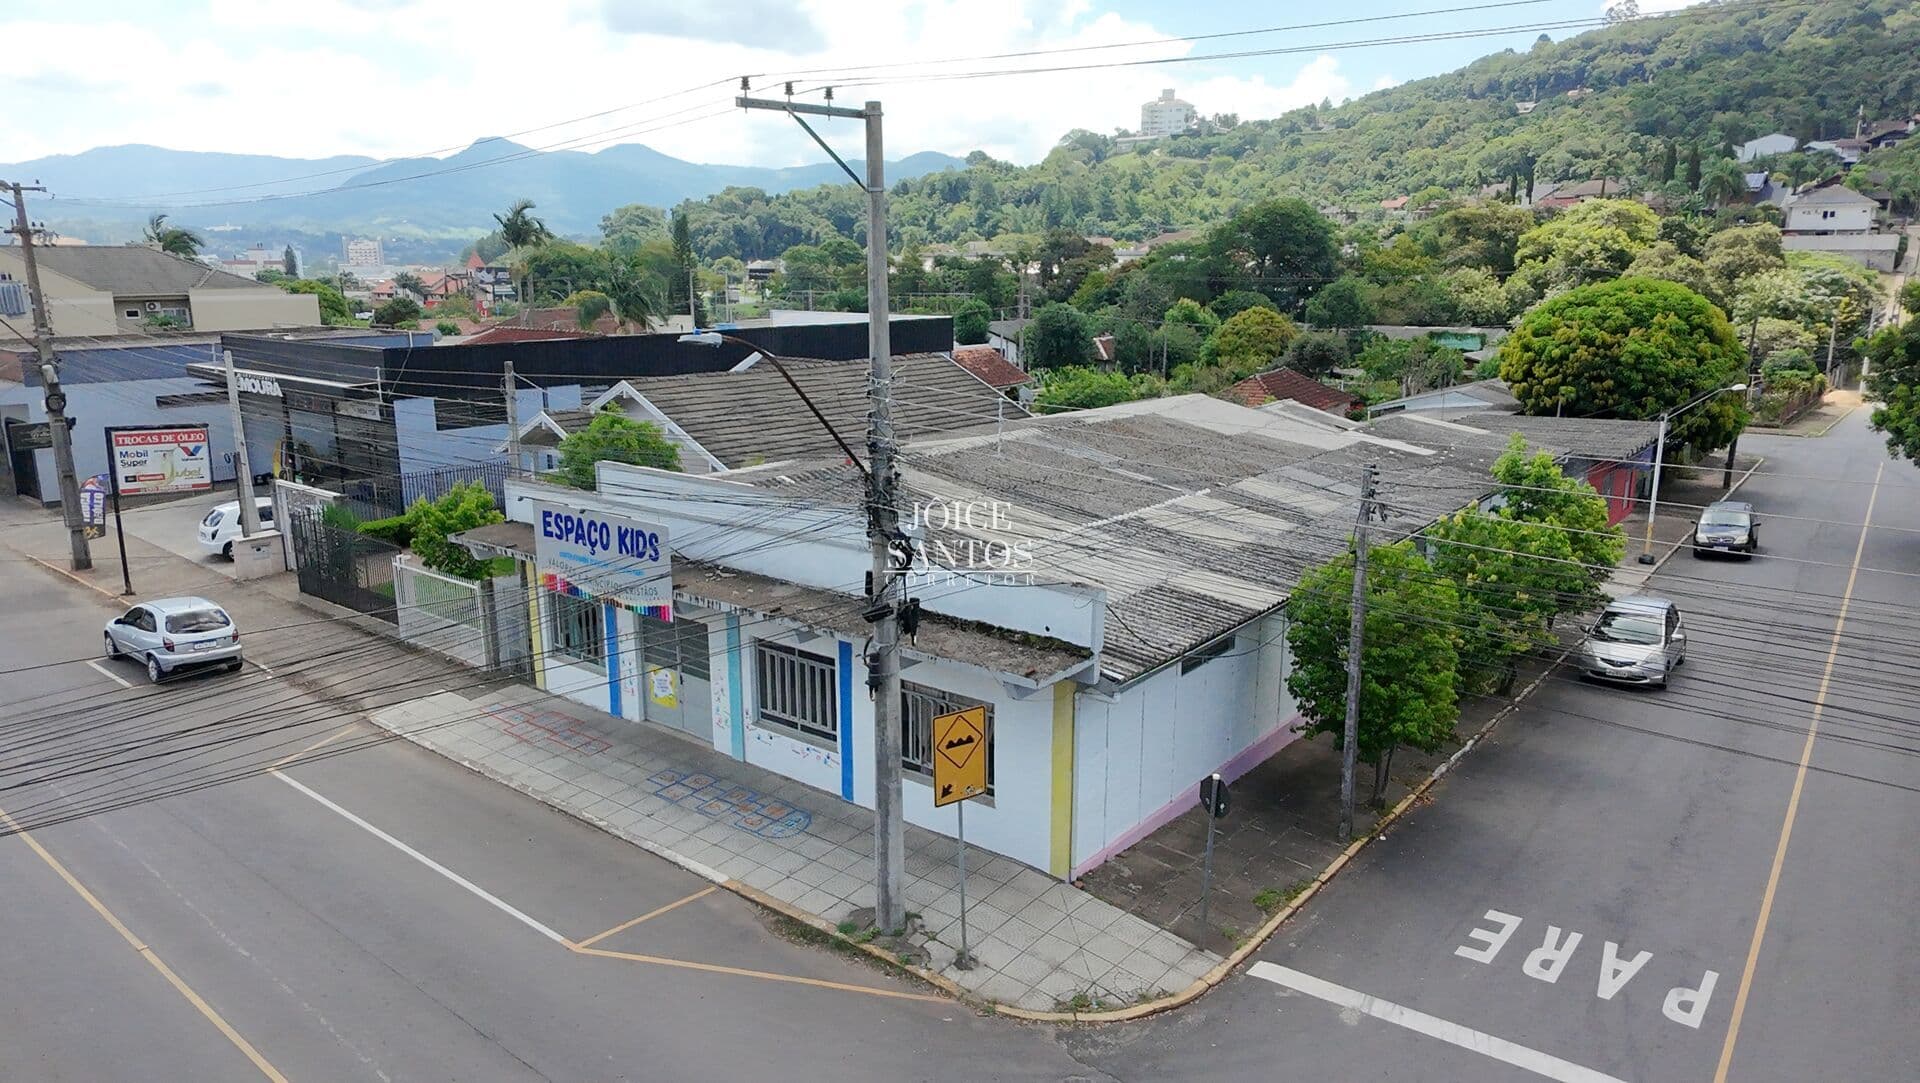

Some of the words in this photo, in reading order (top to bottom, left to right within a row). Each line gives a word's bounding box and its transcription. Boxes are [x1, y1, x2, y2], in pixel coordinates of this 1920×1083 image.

[117, 435, 159, 445] TROCAS
[159, 434, 175, 442] DE
[177, 432, 205, 442] ÓLEO
[120, 449, 149, 458] Mobil
[121, 459, 148, 468] Super
[542, 510, 611, 556] ESPAÇO
[617, 525, 660, 562] KIDS
[1454, 909, 1719, 1029] PARE
